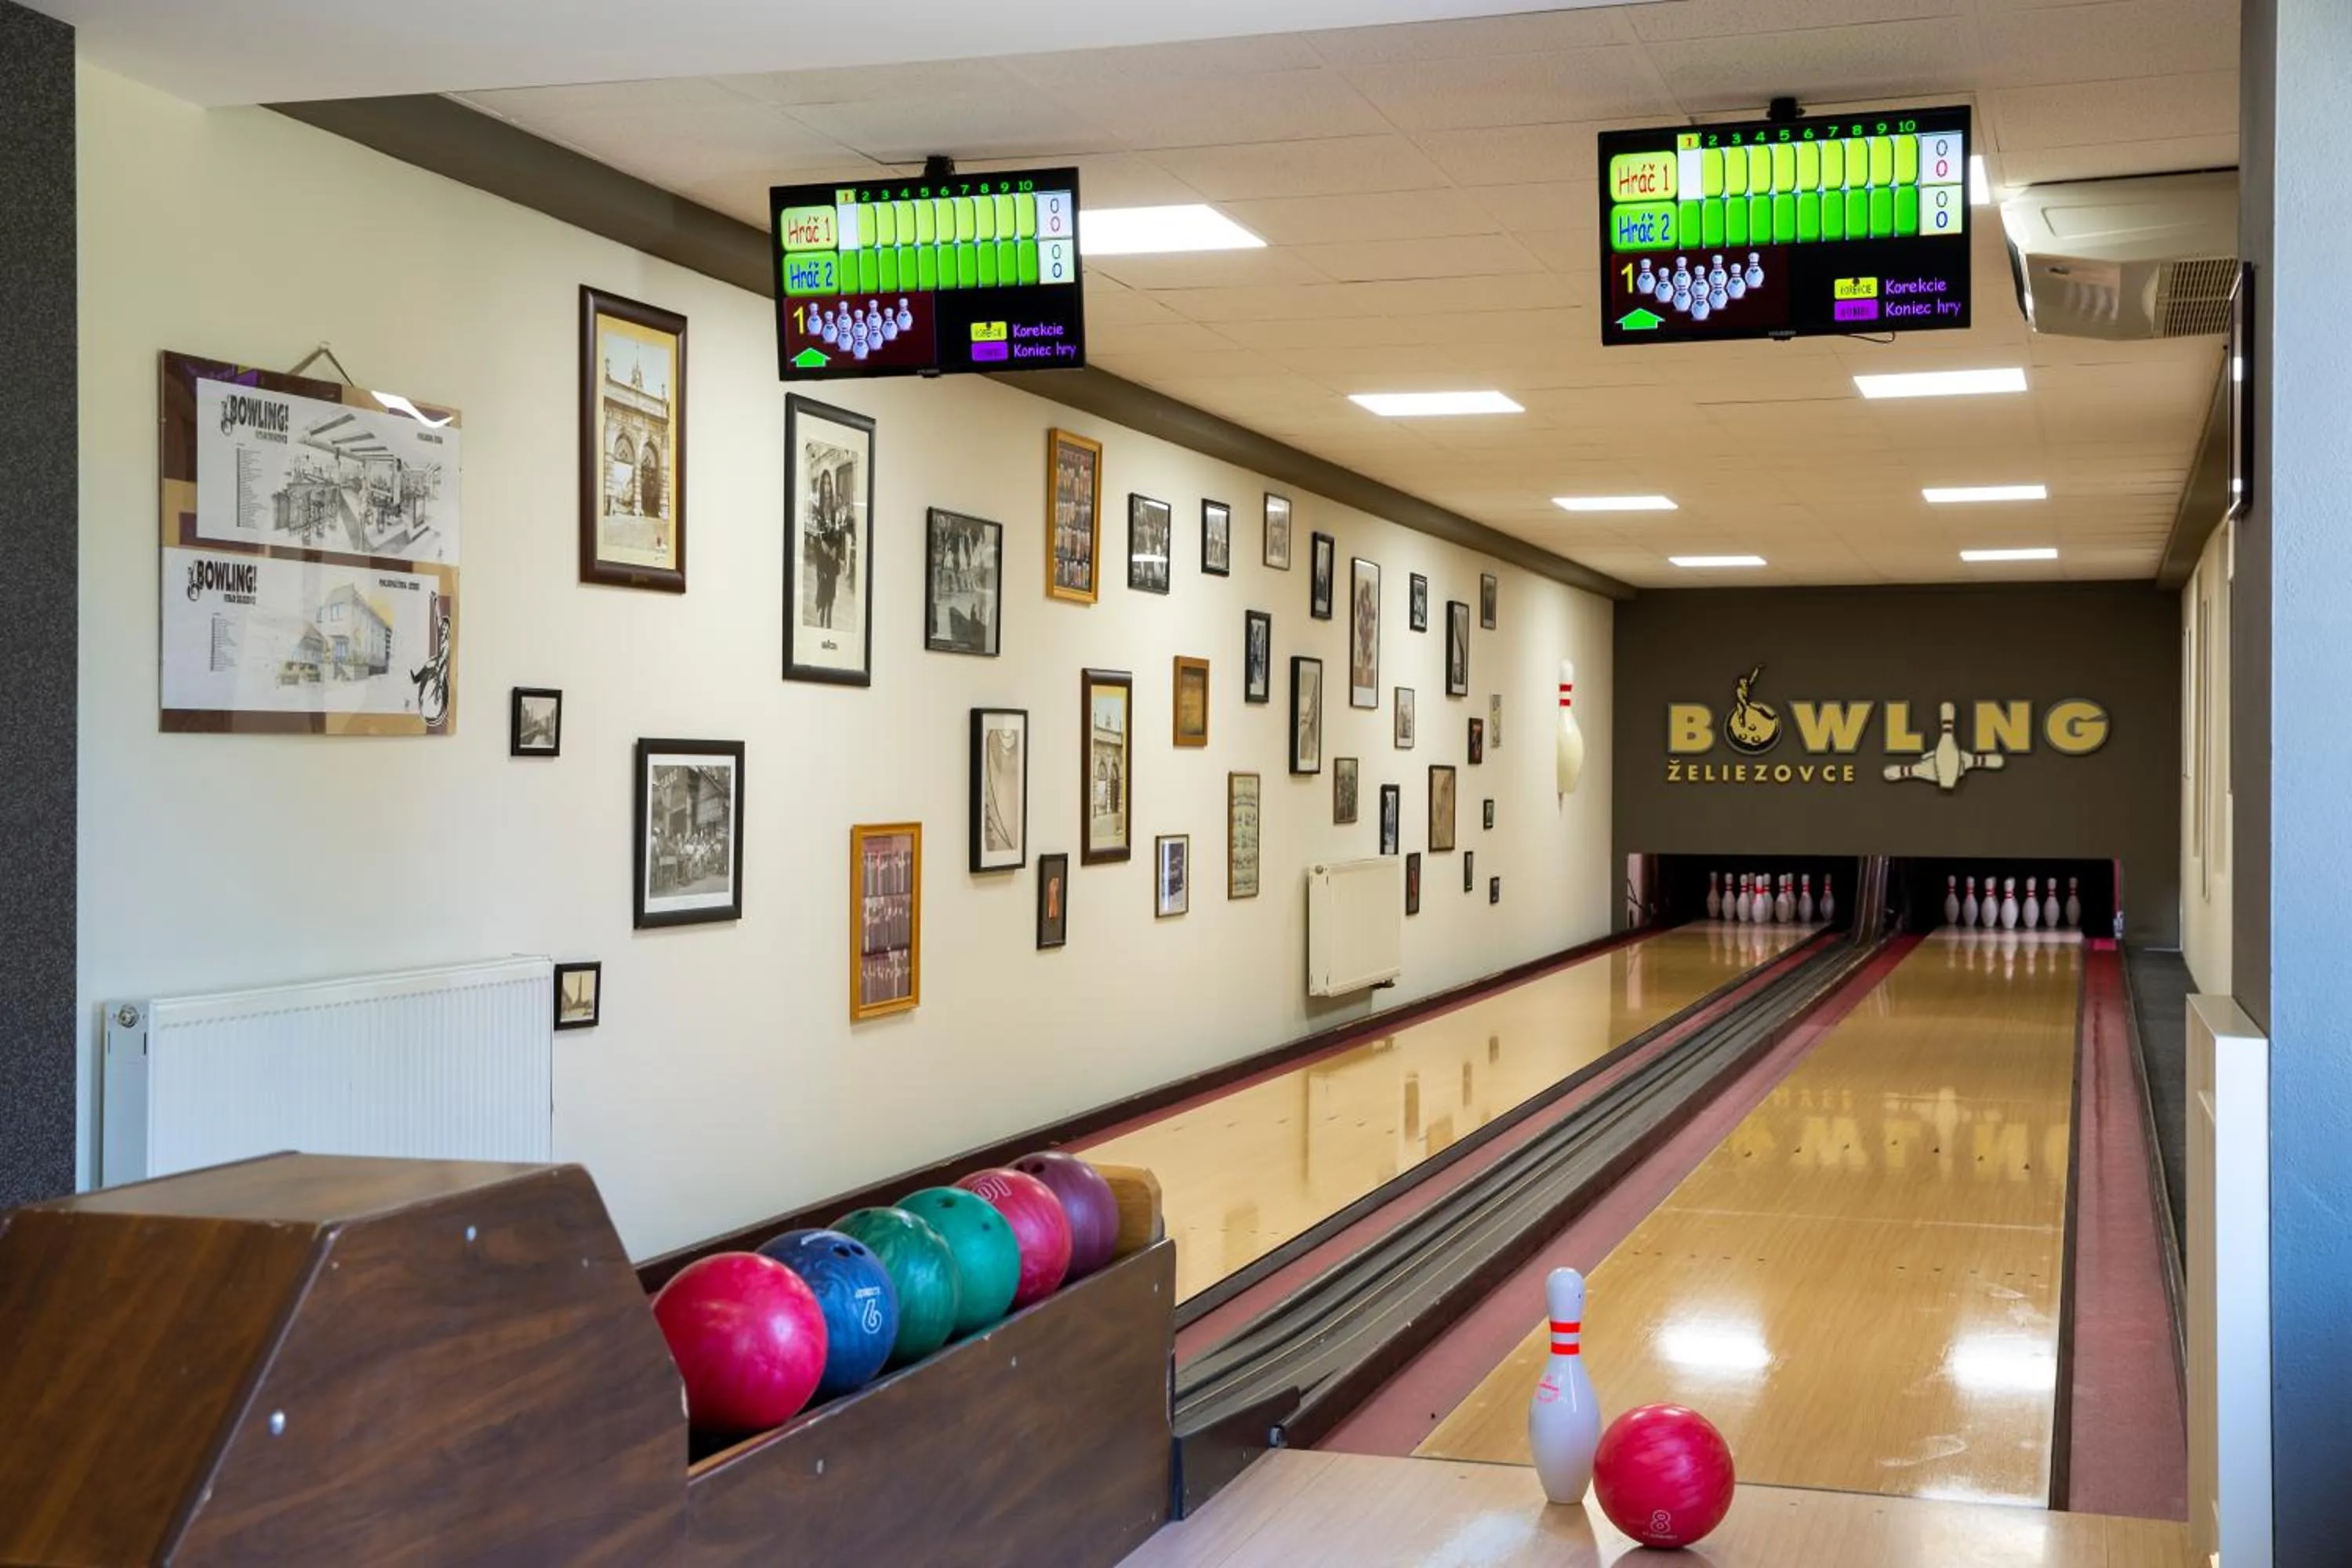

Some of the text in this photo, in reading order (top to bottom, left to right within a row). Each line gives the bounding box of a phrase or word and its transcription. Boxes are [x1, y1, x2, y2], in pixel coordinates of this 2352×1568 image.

[1708, 135, 1718, 146] 2
[1732, 133, 1741, 144] 3
[1755, 132, 1766, 142] 4
[1780, 129, 1790, 141] 5
[1804, 129, 1814, 139] 6
[1828, 126, 1838, 137] 7
[1852, 125, 1862, 136] 8
[1876, 123, 1887, 134] 9
[1898, 120, 1916, 132] 10
[1936, 139, 1948, 157] 0
[1936, 159, 1948, 178] 0
[1618, 163, 1669, 195] Hráč 1
[862, 191, 869, 201] 2
[880, 189, 890, 200] 3
[900, 188, 909, 198] 4
[920, 187, 929, 198] 5
[940, 187, 949, 197] 6
[960, 184, 970, 194] 7
[980, 183, 989, 194] 8
[1000, 181, 1010, 192] 9
[1018, 180, 1033, 191] 10
[1936, 191, 1948, 208] 0
[1050, 198, 1059, 214] 0
[1051, 216, 1061, 232] 0
[1618, 212, 1670, 245] Hráč 2
[1936, 211, 1948, 228] 0
[788, 216, 831, 245] Hráč 1
[1051, 244, 1061, 260] 0
[789, 260, 833, 289] Hráč 2
[1052, 262, 1062, 278] 0
[1621, 263, 1634, 294] 1
[1885, 277, 1947, 295] Korekcie
[1885, 299, 1932, 318] Koniec
[1936, 298, 1961, 318] hry
[793, 306, 804, 335] 1
[1012, 321, 1065, 338] Korekcie
[1013, 342, 1052, 358] Koniec
[1056, 340, 1076, 360] hry
[230, 394, 289, 433] BOWLING!
[1666, 758, 1857, 782] ŽELIEZOVCE
[1650, 1509, 1671, 1534] 8
